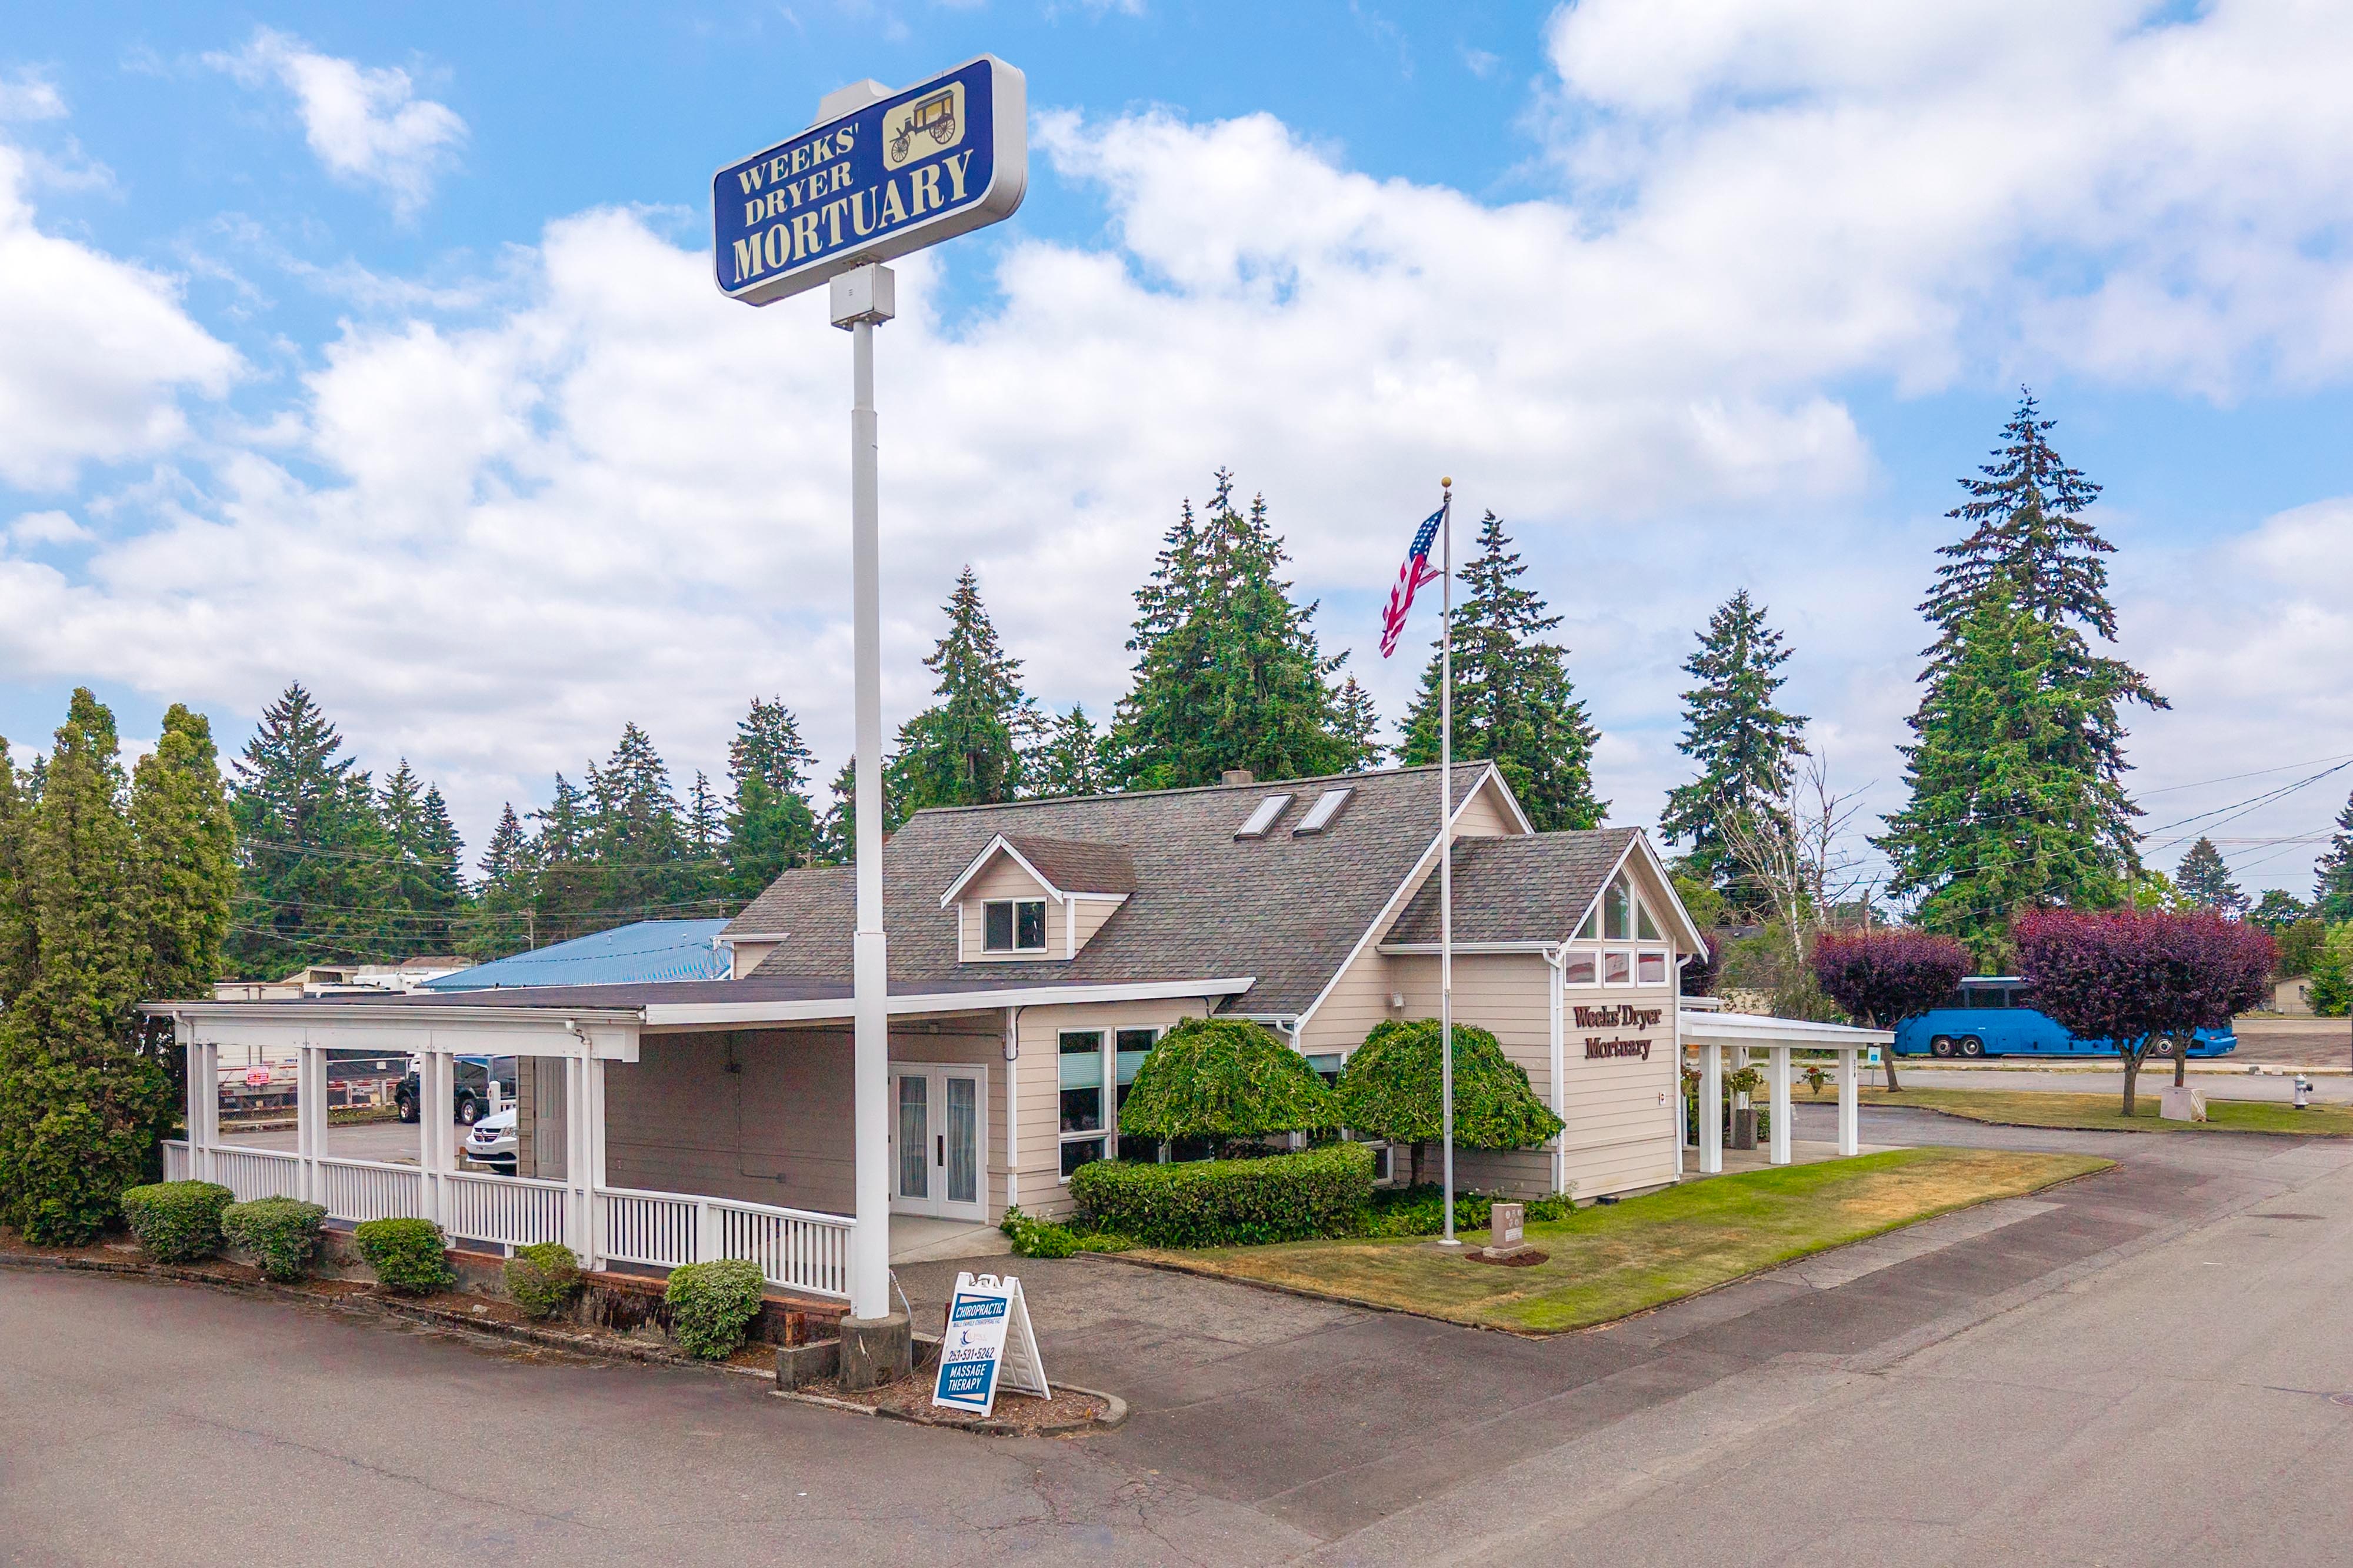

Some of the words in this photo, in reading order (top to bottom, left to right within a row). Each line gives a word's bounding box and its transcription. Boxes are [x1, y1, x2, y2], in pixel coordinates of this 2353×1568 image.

[745, 162, 854, 227] DRYER
[733, 149, 974, 283] MORTUARY
[1622, 1005, 1662, 1030] Dryer
[1585, 1036, 1652, 1060] Mortuary
[955, 1302, 1005, 1318] CHIROPRACTIC
[950, 1364, 987, 1378] MASSAGE
[948, 1377, 982, 1391] THERAPY
